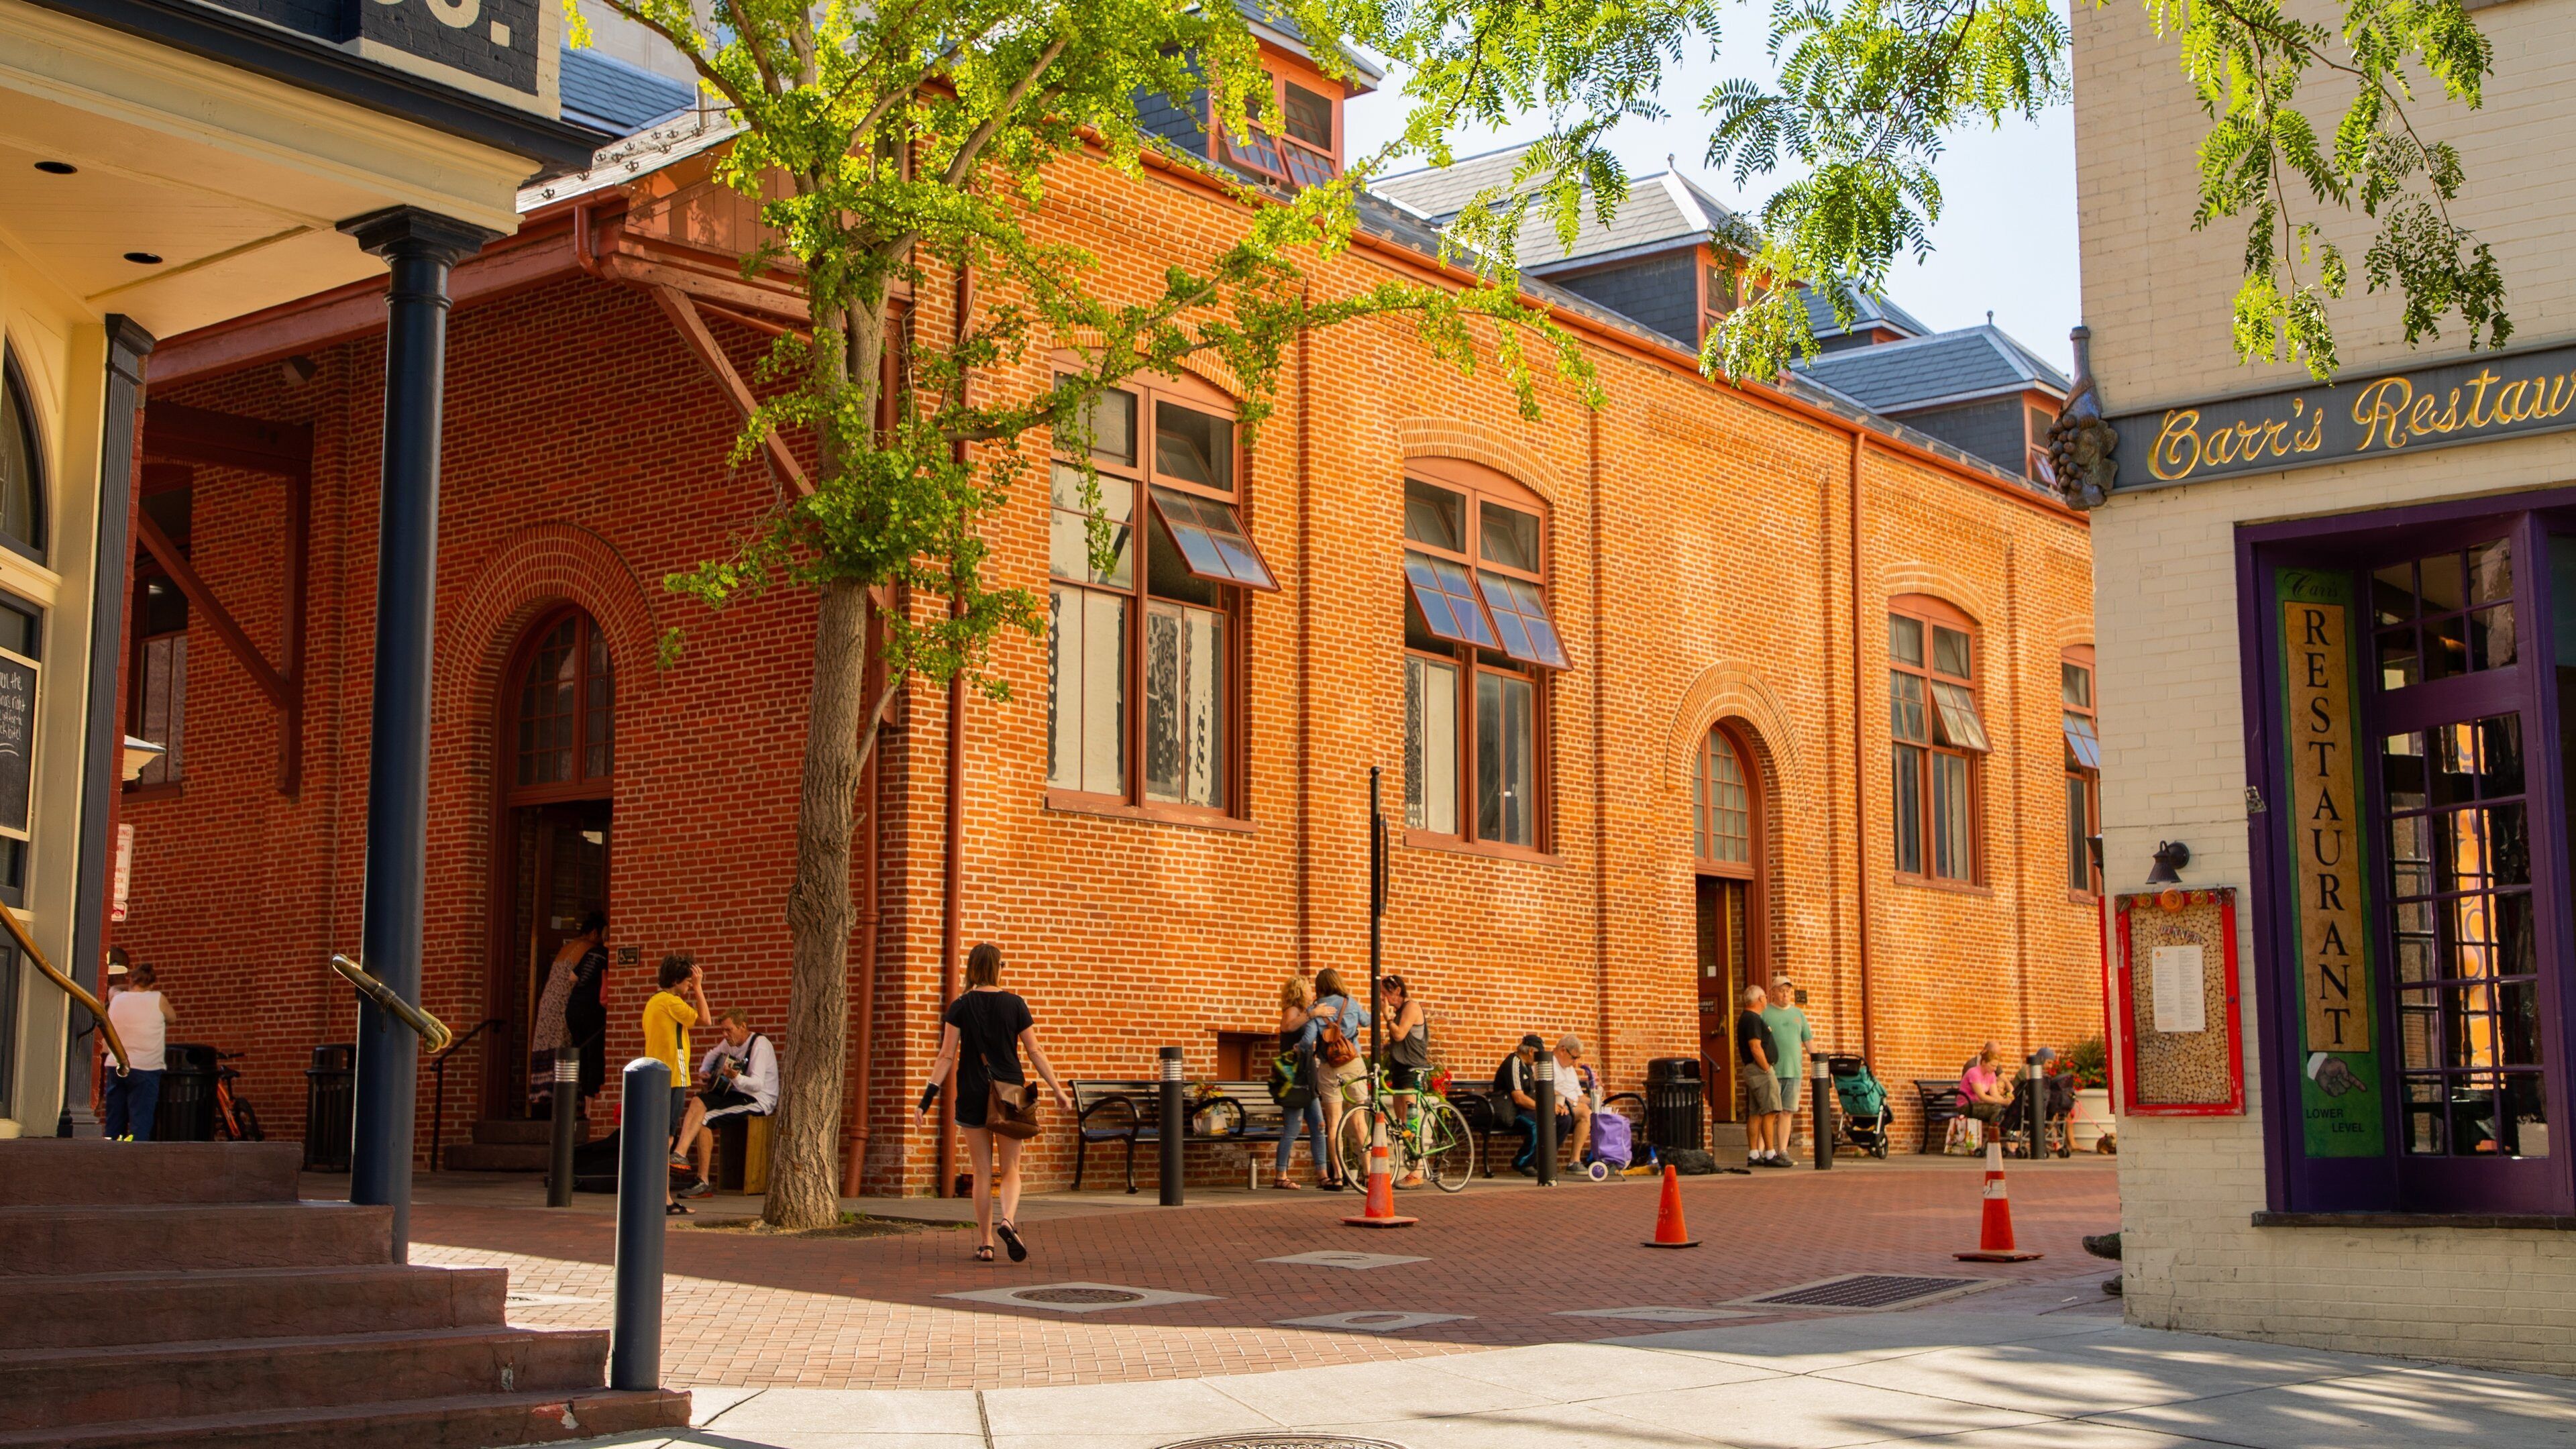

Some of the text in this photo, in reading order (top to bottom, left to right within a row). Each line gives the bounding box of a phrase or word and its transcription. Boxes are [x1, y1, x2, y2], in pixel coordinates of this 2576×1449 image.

[2147, 397, 2323, 480] Carr's
[10, 672, 23, 691] the
[2303, 609, 2351, 1044] RESTAURANT
[2306, 1108, 2344, 1119] LOWER
[2332, 1122, 2365, 1132] LEVEL
